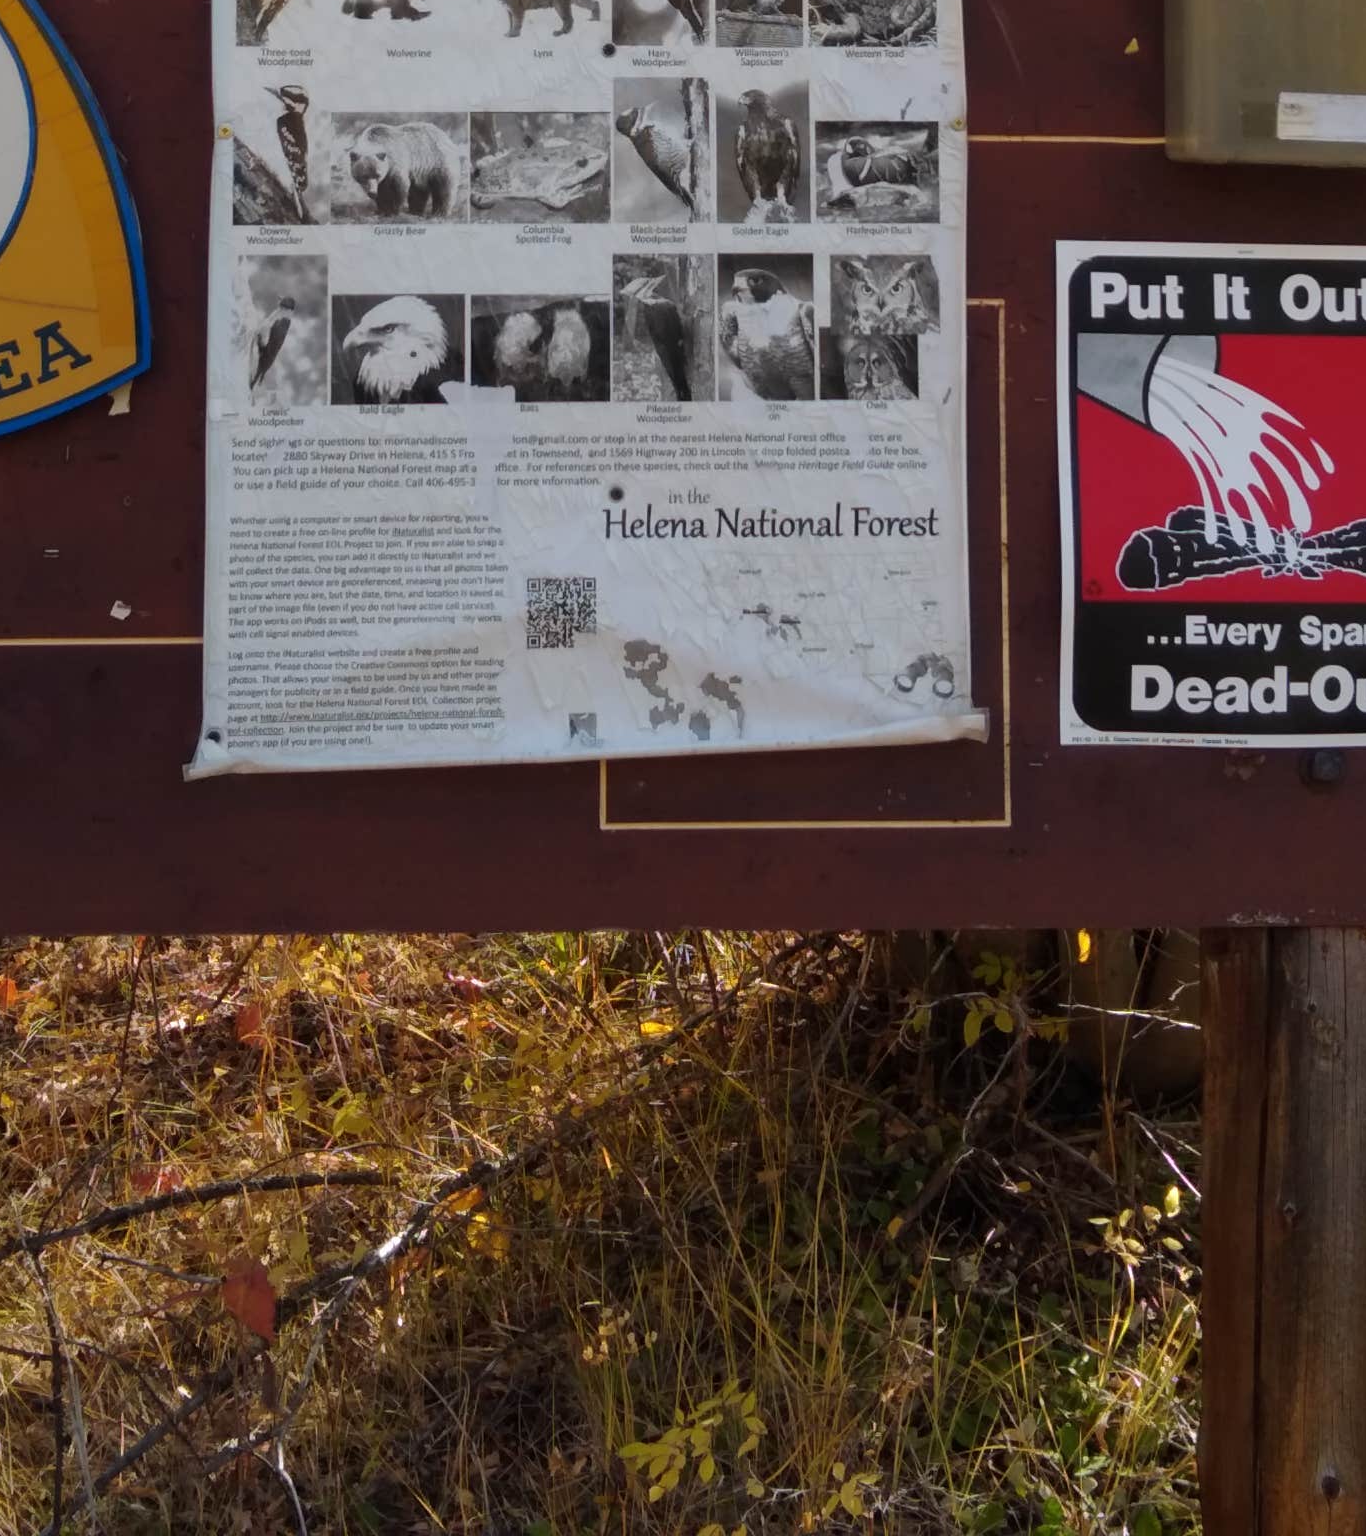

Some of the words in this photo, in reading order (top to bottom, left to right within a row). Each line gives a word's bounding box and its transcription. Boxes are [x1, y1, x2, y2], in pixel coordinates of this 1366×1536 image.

[387, 49, 432, 58] Wolverine
[533, 49, 553, 60] Lynx
[648, 49, 671, 60] Hairy
[845, 49, 883, 59] Western
[406, 226, 427, 235] Bear
[523, 226, 564, 235] Columbia
[732, 226, 764, 236] Golden
[515, 235, 550, 245] Spotted
[552, 235, 572, 245] Frog
[1090, 272, 1184, 320] Put
[1213, 273, 1251, 321] It
[359, 404, 380, 414] Bald
[248, 417, 304, 427] Woodpecker
[636, 414, 692, 424] Woodpecker
[668, 489, 683, 504] in
[688, 488, 711, 505] the
[603, 504, 708, 539] Helena
[715, 502, 843, 538] National
[851, 507, 939, 538] Forest
[1147, 615, 1282, 651] ...Every
